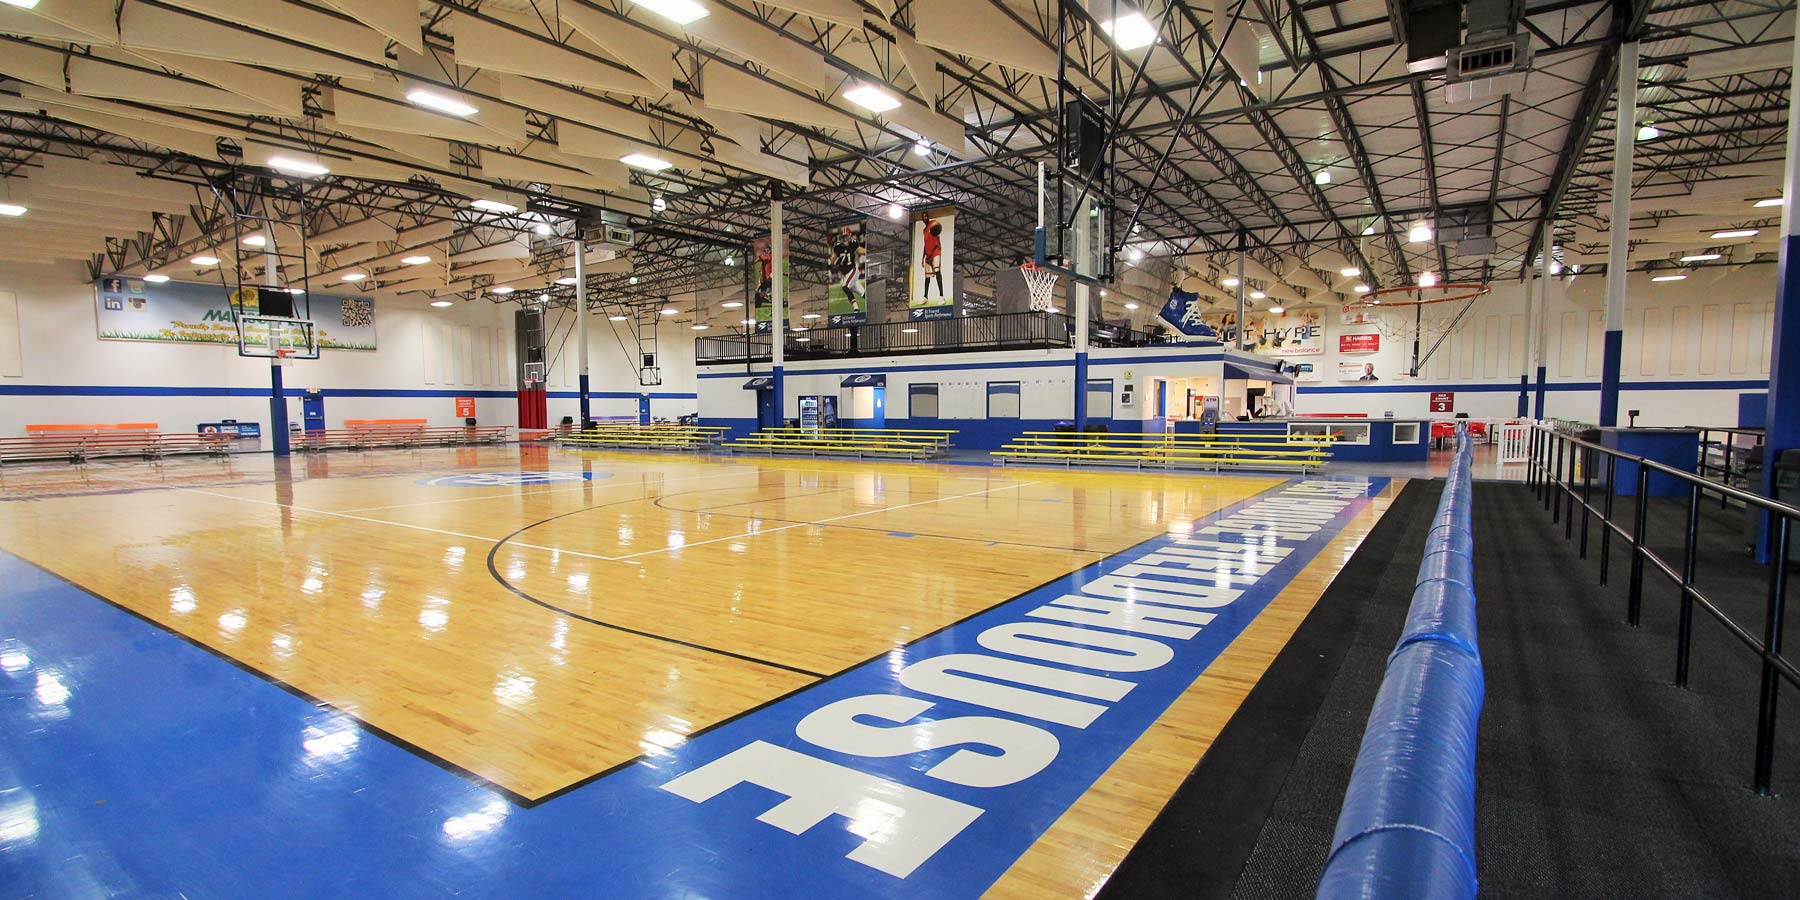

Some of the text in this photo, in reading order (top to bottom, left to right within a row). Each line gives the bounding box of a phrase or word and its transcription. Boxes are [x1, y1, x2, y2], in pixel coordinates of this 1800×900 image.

[839, 252, 852, 266] 71
[106, 297, 121, 309] in
[1264, 325, 1321, 340] HYPE
[462, 407, 470, 417] 5
[1437, 402, 1446, 411] 3
[1195, 497, 1351, 542] CHOICE
[659, 538, 1296, 880] FIELDHOUSE
